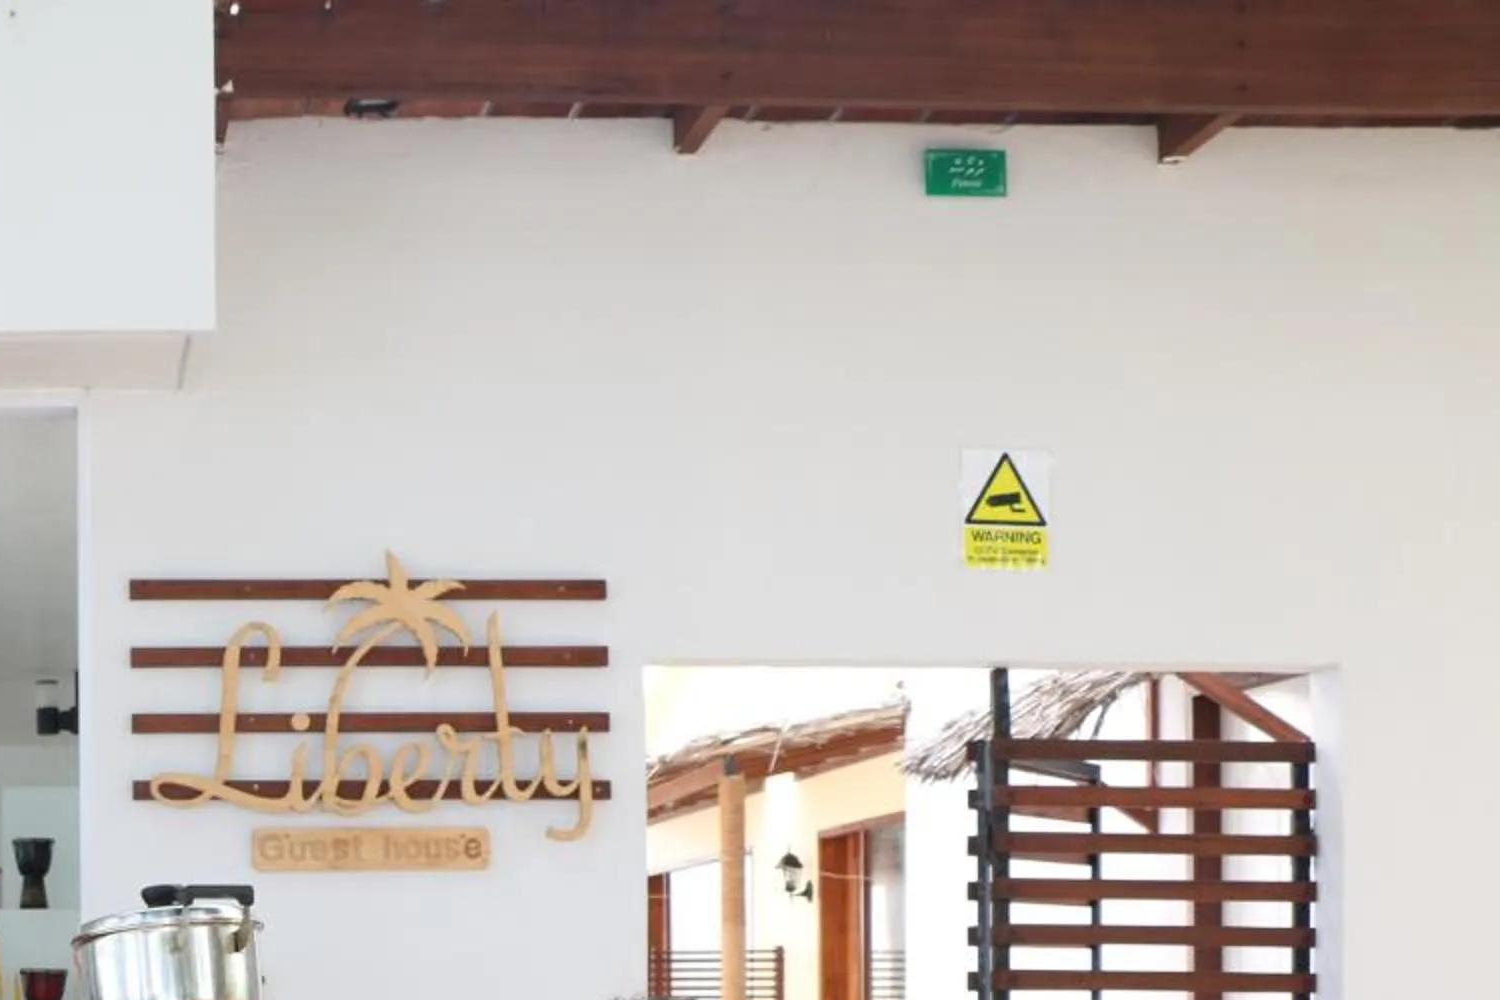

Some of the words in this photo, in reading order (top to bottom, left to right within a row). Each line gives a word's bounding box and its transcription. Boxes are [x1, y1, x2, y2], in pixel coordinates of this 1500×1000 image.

[971, 529, 1042, 545] WARNING
[150, 605, 595, 842] Liberty
[259, 832, 366, 862] Guest
[384, 832, 484, 862] house
